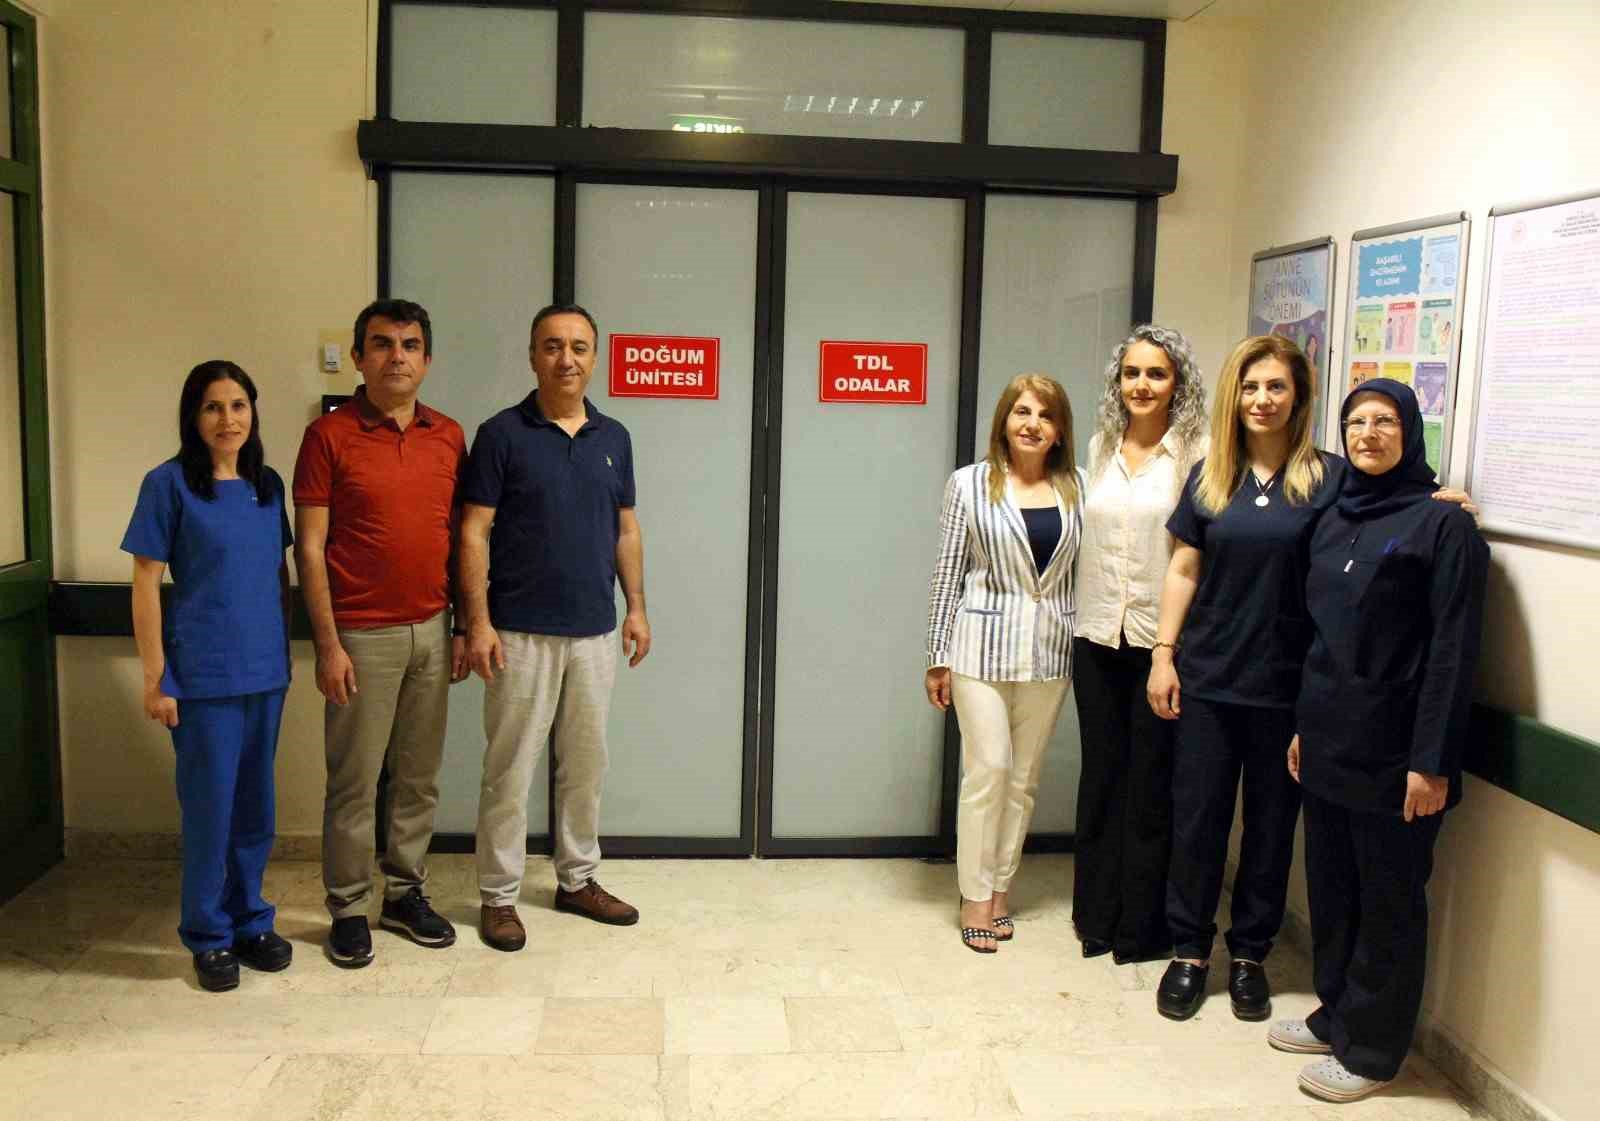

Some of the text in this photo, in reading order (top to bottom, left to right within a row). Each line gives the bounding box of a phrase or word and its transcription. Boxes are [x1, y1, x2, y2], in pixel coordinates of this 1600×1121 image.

[625, 345, 705, 365] DOĞUM
[853, 354, 894, 371] TDL
[625, 368, 703, 387] ÜNİTESİ
[834, 377, 911, 394] ODALAR
